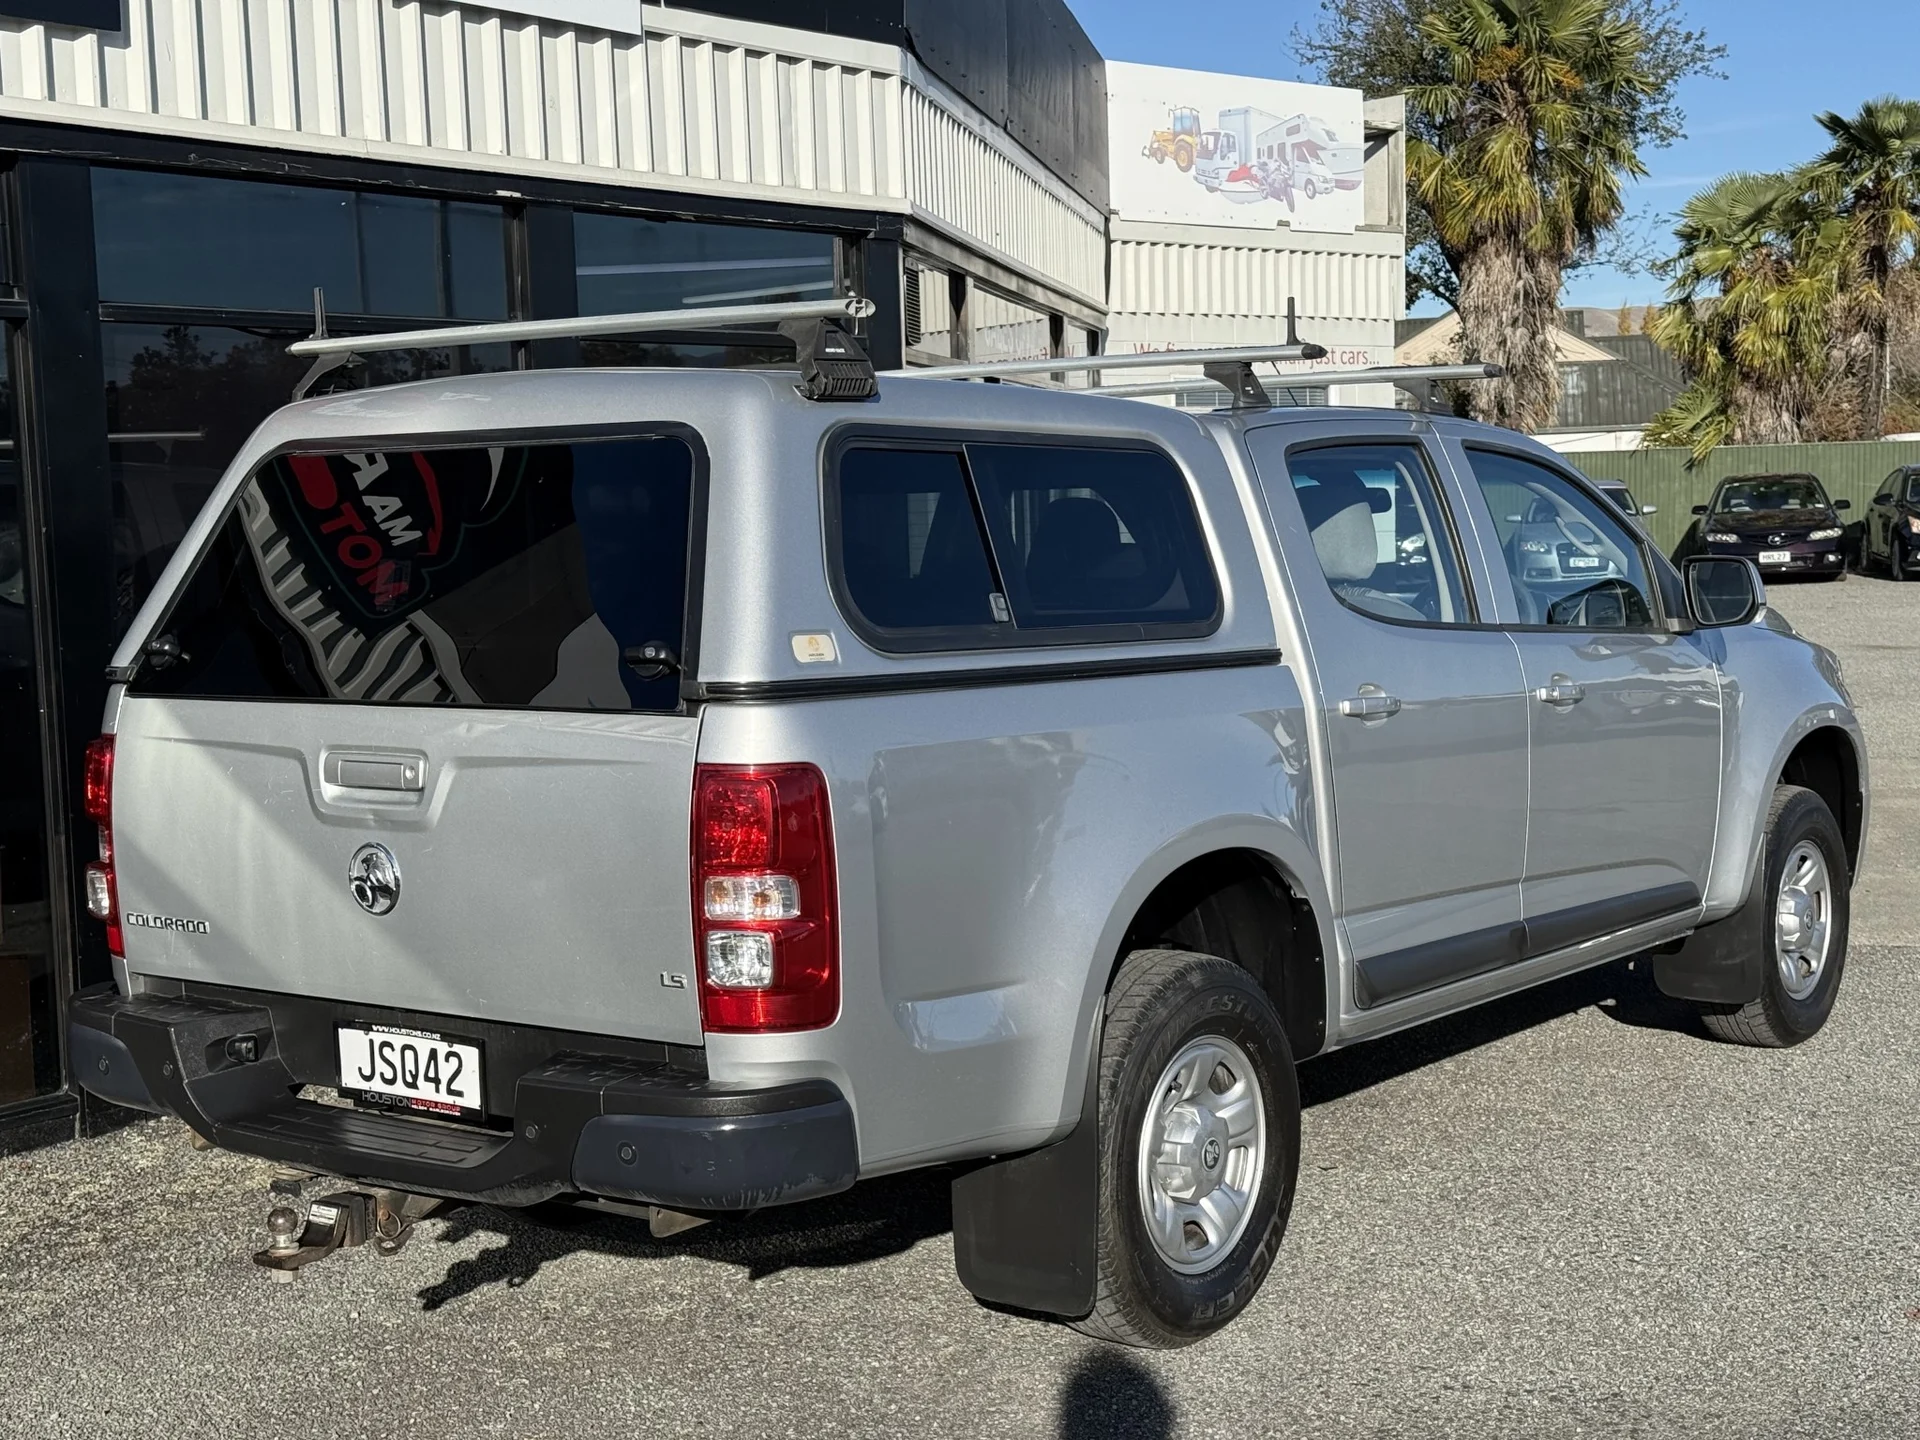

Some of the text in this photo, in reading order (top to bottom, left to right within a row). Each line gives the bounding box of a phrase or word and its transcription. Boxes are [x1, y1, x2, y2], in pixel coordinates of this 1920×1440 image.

[126, 911, 210, 934] COLORADO
[660, 971, 687, 989] LS
[357, 1038, 465, 1098] JSQ42
[361, 1090, 412, 1108] HOUSTON
[411, 1098, 462, 1112] MOTOR GROUP
